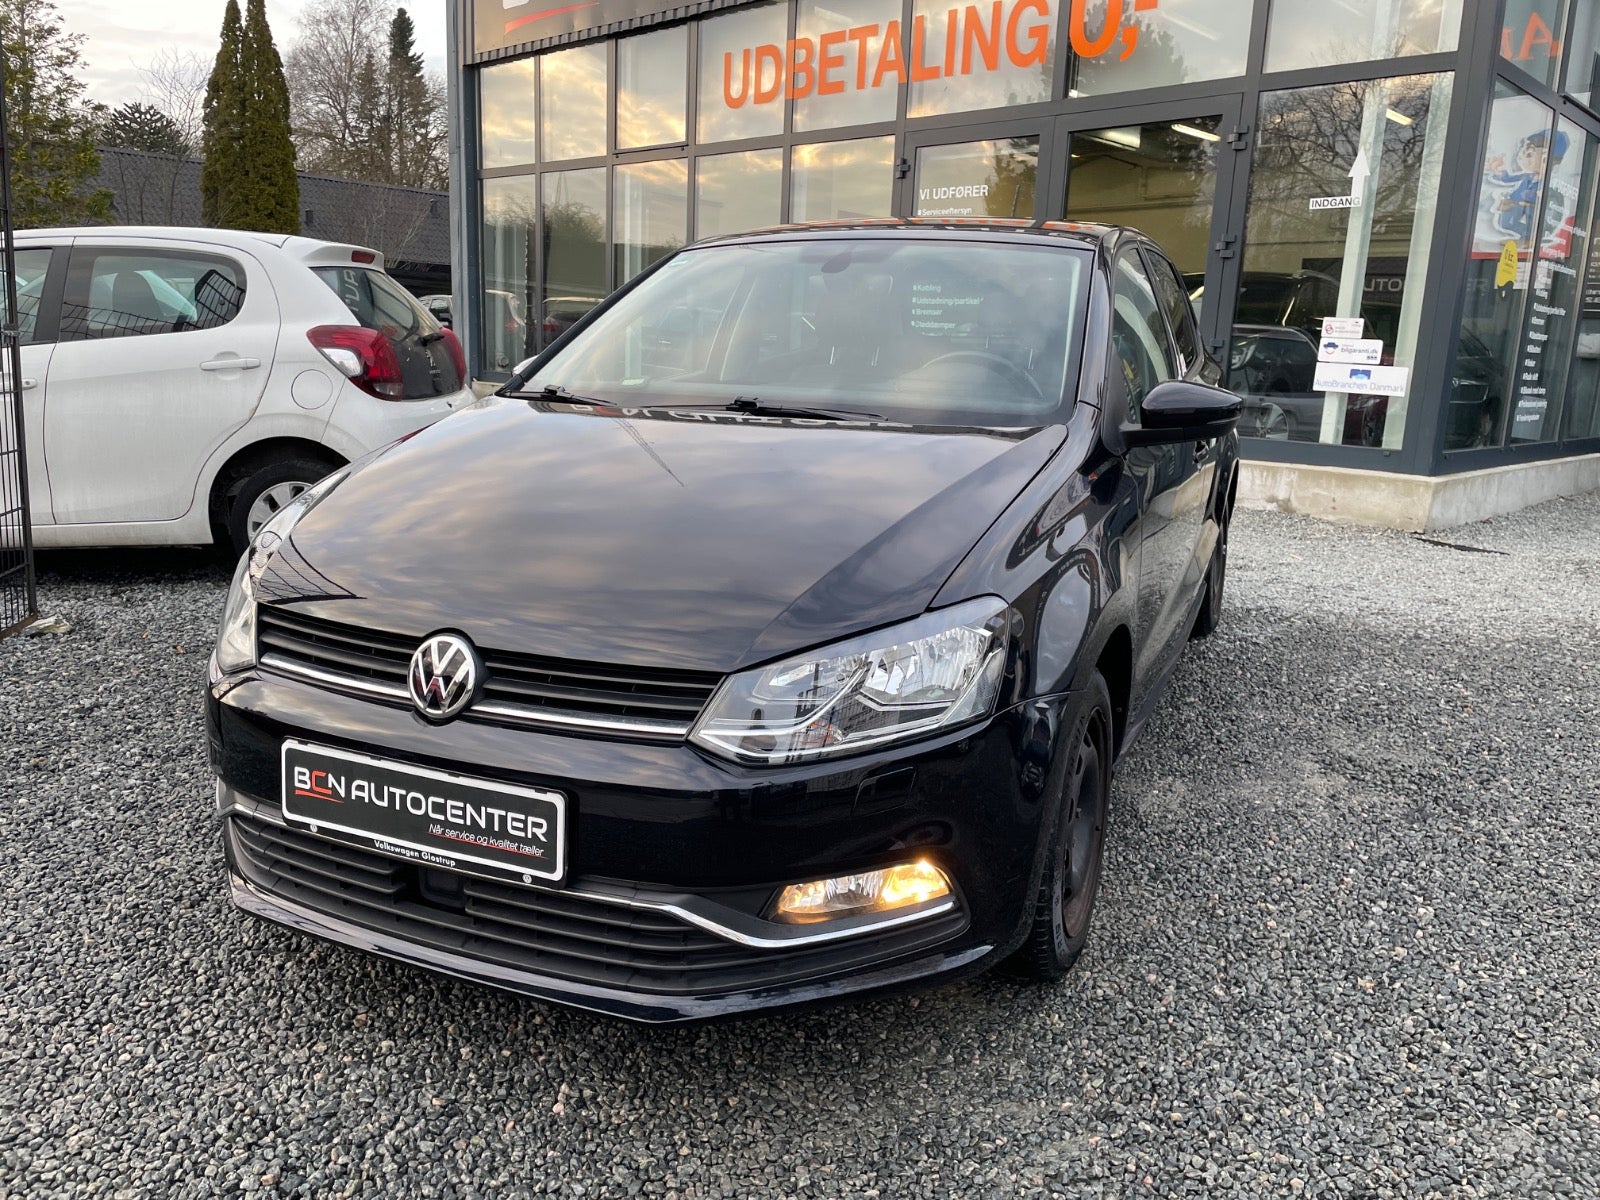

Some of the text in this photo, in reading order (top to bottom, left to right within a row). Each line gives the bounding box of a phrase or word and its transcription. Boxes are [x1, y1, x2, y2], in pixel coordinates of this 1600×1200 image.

[723, 0, 1050, 109] UDBETALING
[919, 184, 989, 200] VI UDFØRER
[1311, 197, 1360, 208] INDGANG
[1369, 382, 1404, 392] Danmark
[294, 766, 548, 843] BCN AUTOCENTER
[374, 839, 456, 868] Volkswagen Glostrup
[428, 823, 544, 857] Når service og kvalitet tæller
